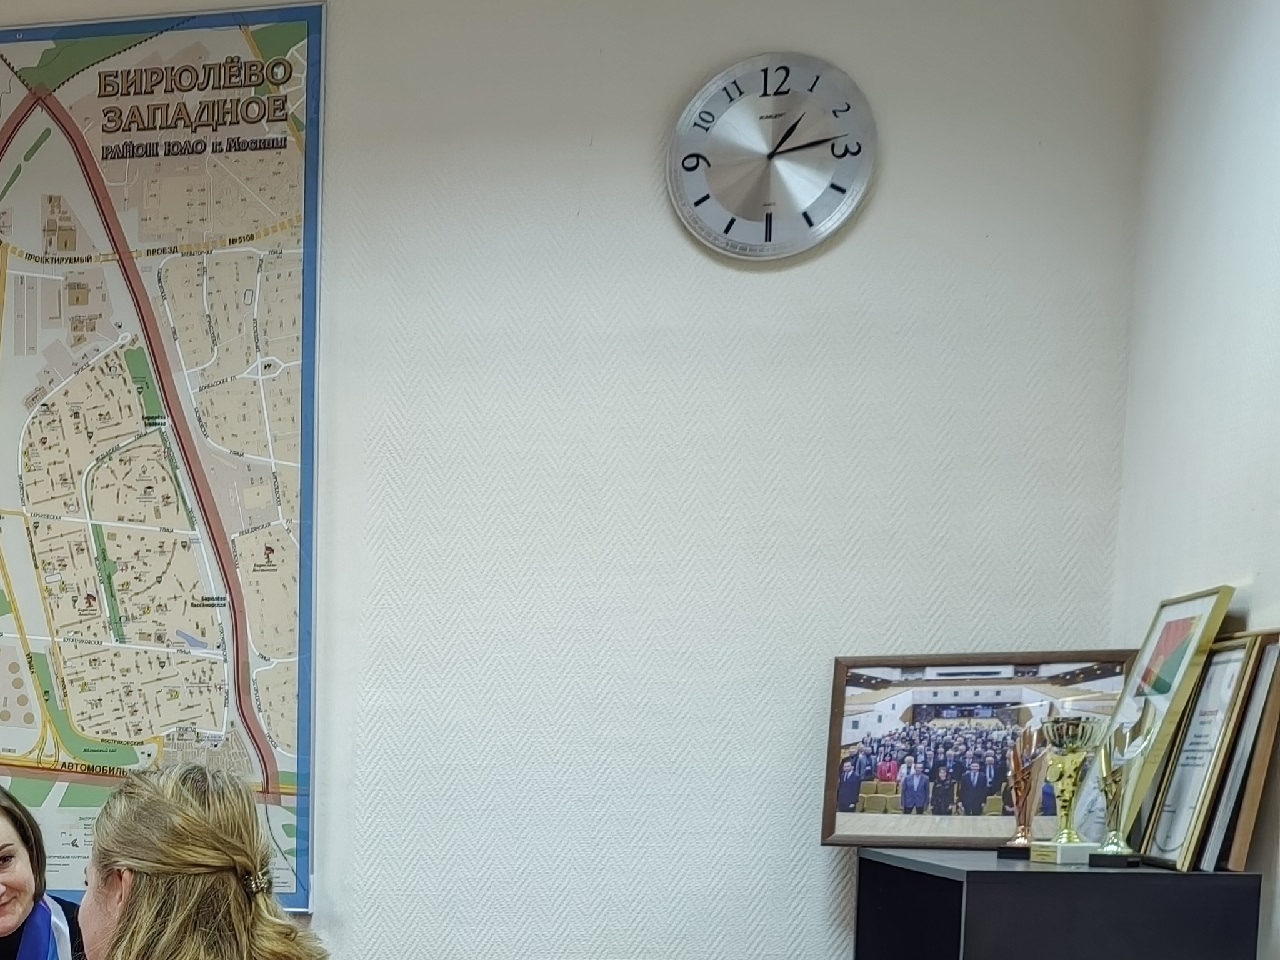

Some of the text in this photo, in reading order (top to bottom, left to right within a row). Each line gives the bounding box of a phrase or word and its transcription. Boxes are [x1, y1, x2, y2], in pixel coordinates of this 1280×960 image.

[97, 56, 293, 98] БИРЮЛЁВО
[758, 66, 791, 97] 12
[807, 75, 820, 93] 1
[722, 80, 745, 103] 11
[101, 94, 288, 133] ЗАПАДНОЕ
[832, 102, 851, 118] 2
[693, 110, 715, 133] 10
[101, 140, 159, 160] РАЙОН
[226, 136, 288, 151] Москвы
[831, 141, 862, 159] 3
[681, 153, 711, 172] 9
[25, 252, 93, 265] ПРОЕКТИРУЕМЫЙ
[146, 246, 179, 257] ПРОЕЗД
[60, 762, 130, 777] АВТОМОБИЛЬ
